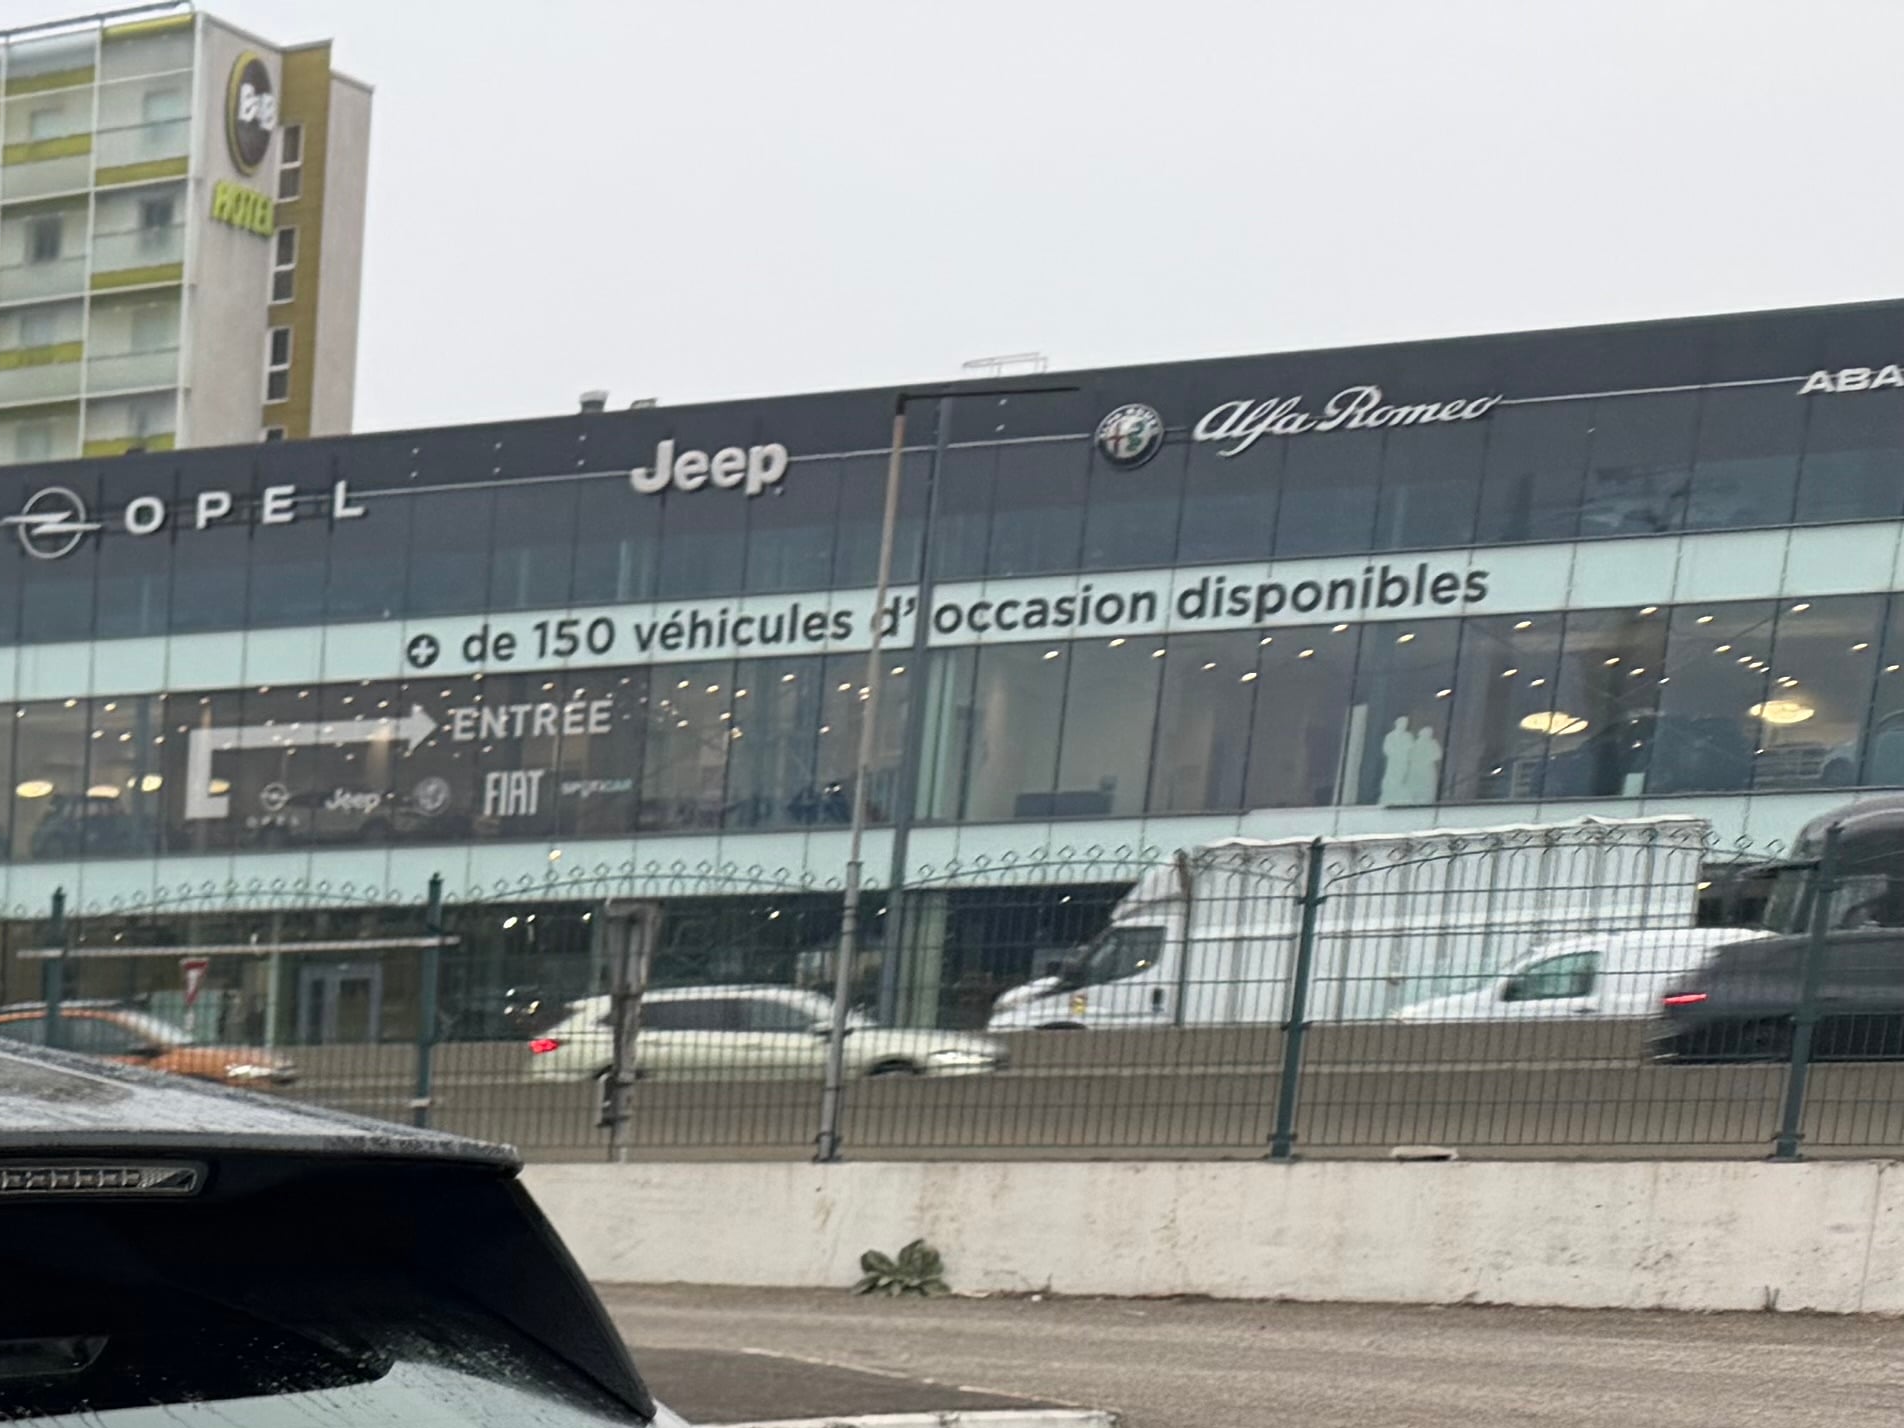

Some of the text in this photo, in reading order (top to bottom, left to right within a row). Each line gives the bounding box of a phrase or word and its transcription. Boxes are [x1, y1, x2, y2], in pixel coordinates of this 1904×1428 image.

[238, 82, 278, 131] BB
[1796, 364, 1904, 396] ABA
[1193, 396, 1316, 458] Alfa
[1313, 385, 1503, 432] Romeo
[629, 437, 789, 497] Jeep
[124, 479, 367, 536] OPEL
[462, 624, 518, 665] de
[533, 616, 616, 660] 150
[633, 600, 854, 655] véhicules
[934, 585, 1159, 637] occasion
[1176, 563, 1490, 624] disponibles
[483, 768, 545, 817] FIAT
